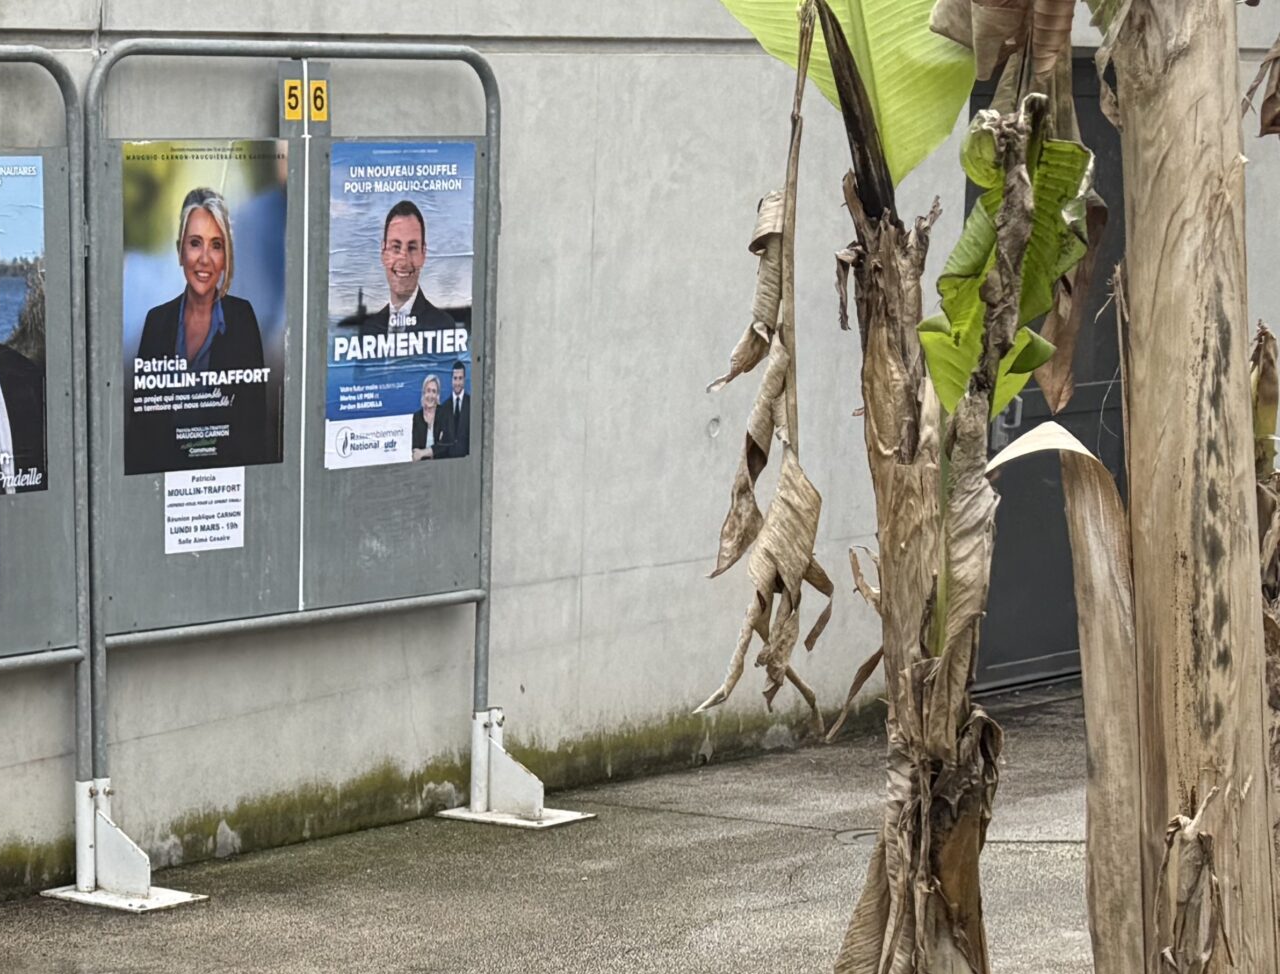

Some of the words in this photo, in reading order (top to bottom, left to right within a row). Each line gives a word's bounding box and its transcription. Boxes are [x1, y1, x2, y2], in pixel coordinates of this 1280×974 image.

[288, 86, 299, 110] 5
[313, 86, 324, 112] 6
[350, 166, 365, 178] UN
[367, 165, 414, 177] NOUVEAU
[416, 164, 457, 176] SOUFFLE
[344, 182, 372, 193] POUR
[374, 179, 462, 193] MAUGUIO-CARNON
[389, 313, 417, 327] Gilles
[334, 328, 468, 362] PARMENTIER
[134, 355, 187, 373] Patricia
[134, 368, 271, 390] MOULLIN-TRAFFORT
[350, 440, 380, 451] National
[191, 474, 216, 482] Patricia
[167, 484, 241, 497] MOULLIN-TRAFFORT
[191, 514, 215, 522] publique
[170, 526, 192, 535] LUNDI
[200, 523, 220, 532] MARS
